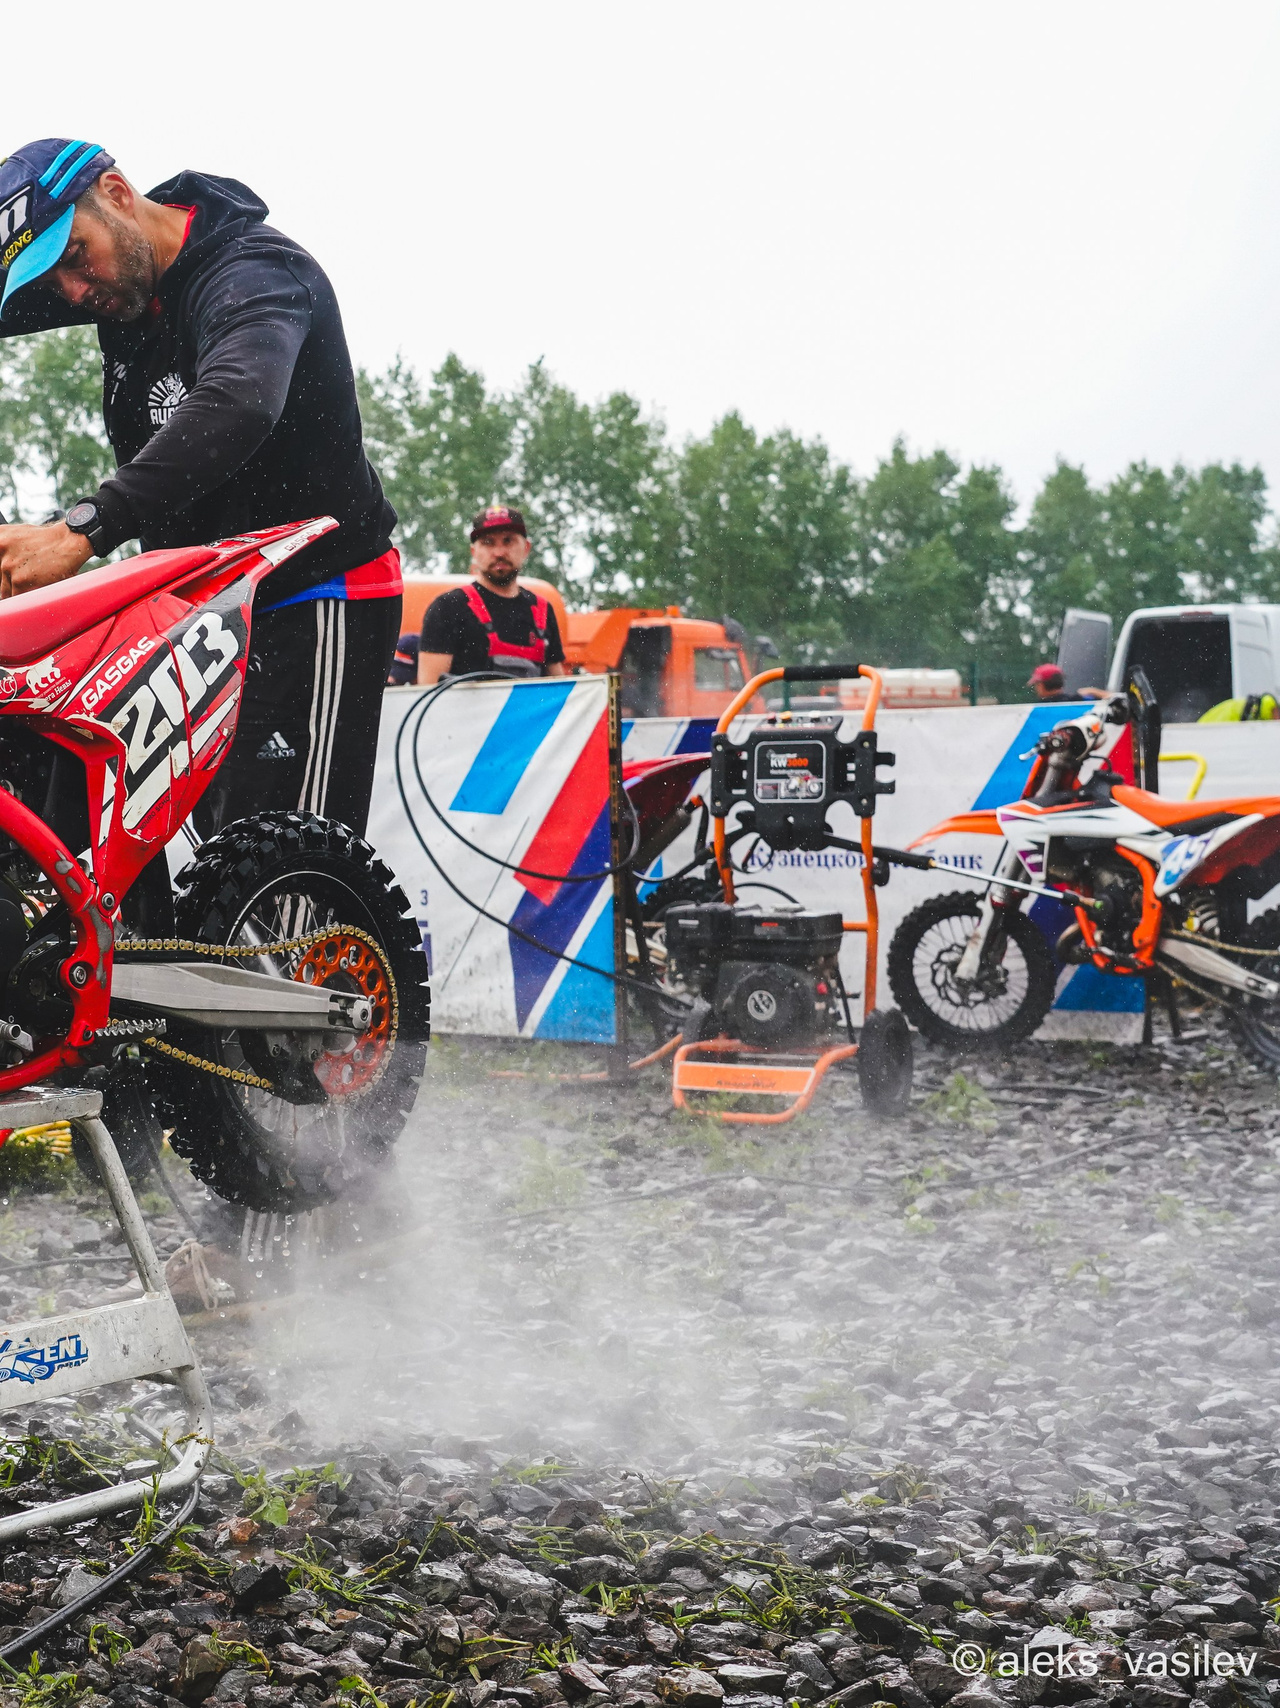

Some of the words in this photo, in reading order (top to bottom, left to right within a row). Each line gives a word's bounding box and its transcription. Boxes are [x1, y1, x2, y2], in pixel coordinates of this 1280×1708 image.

[1, 229, 34, 268] ACING
[81, 636, 156, 711] GASGAS
[111, 612, 239, 775] 203
